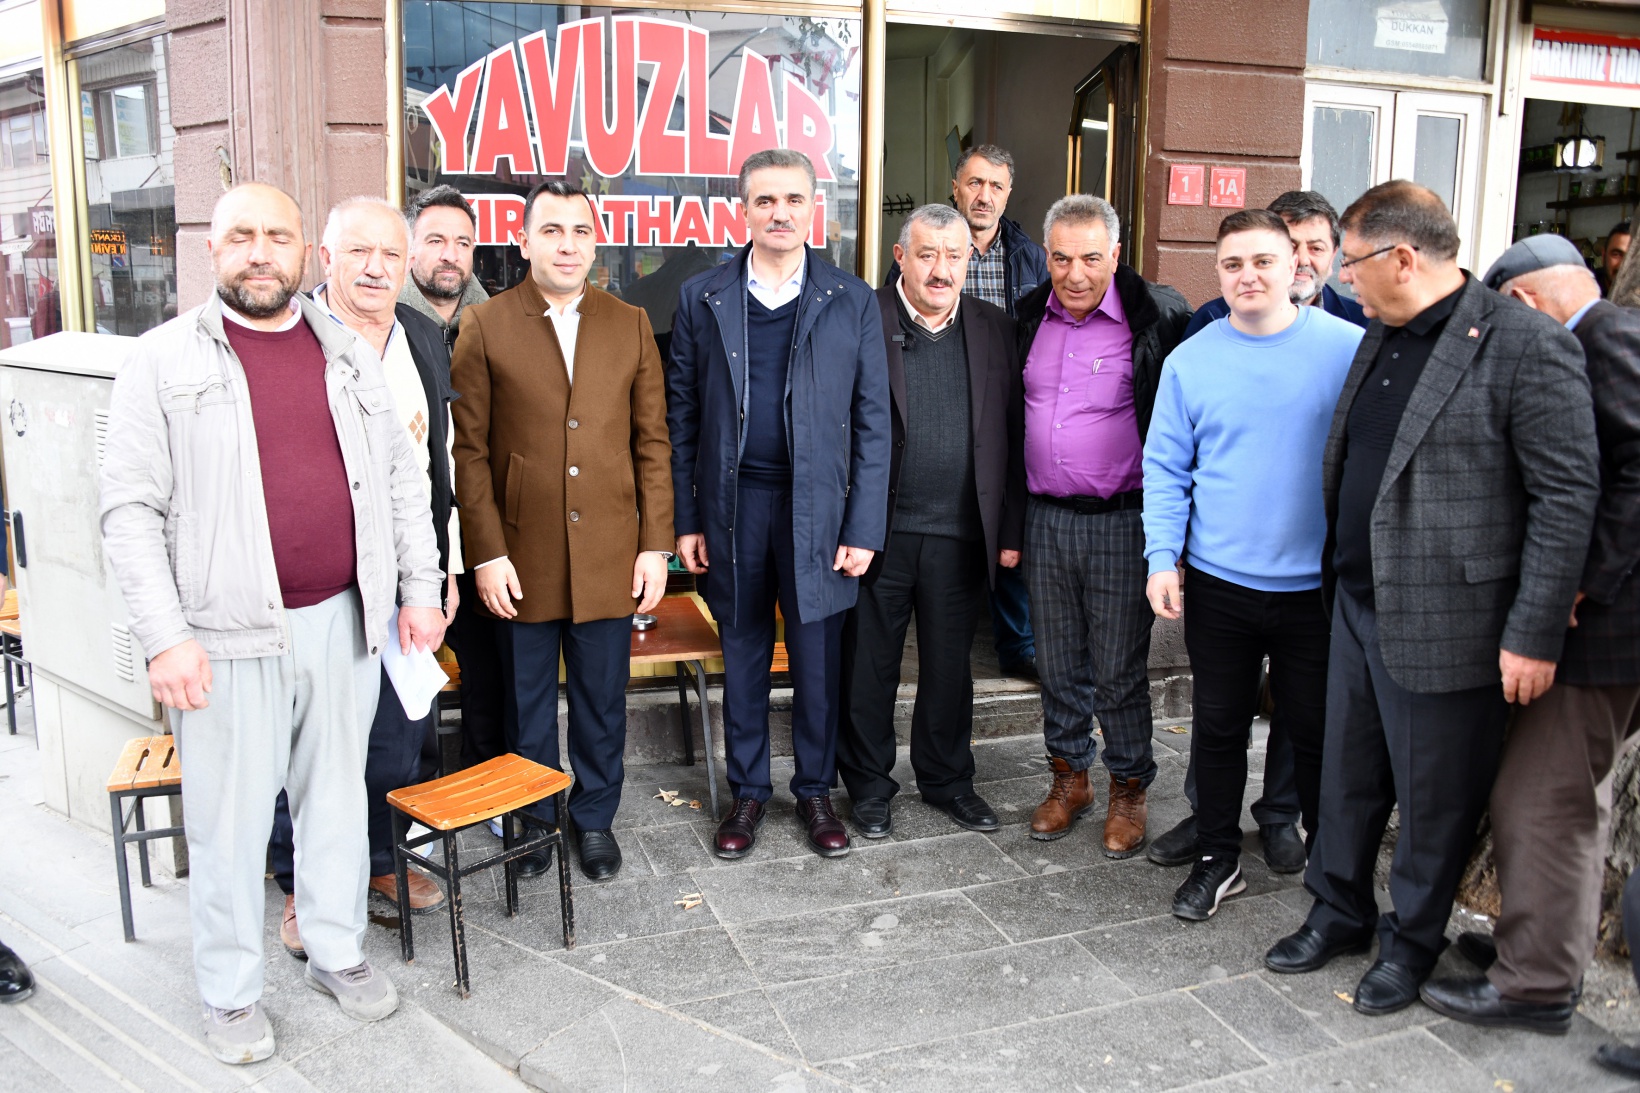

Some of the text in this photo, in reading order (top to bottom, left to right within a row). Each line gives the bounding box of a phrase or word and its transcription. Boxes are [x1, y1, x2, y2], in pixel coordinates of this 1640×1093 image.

[1532, 40, 1607, 82] FARKIMIZ
[420, 15, 837, 182] YAVUZLAR
[1182, 176, 1189, 193] 1
[1218, 178, 1238, 196] 1A
